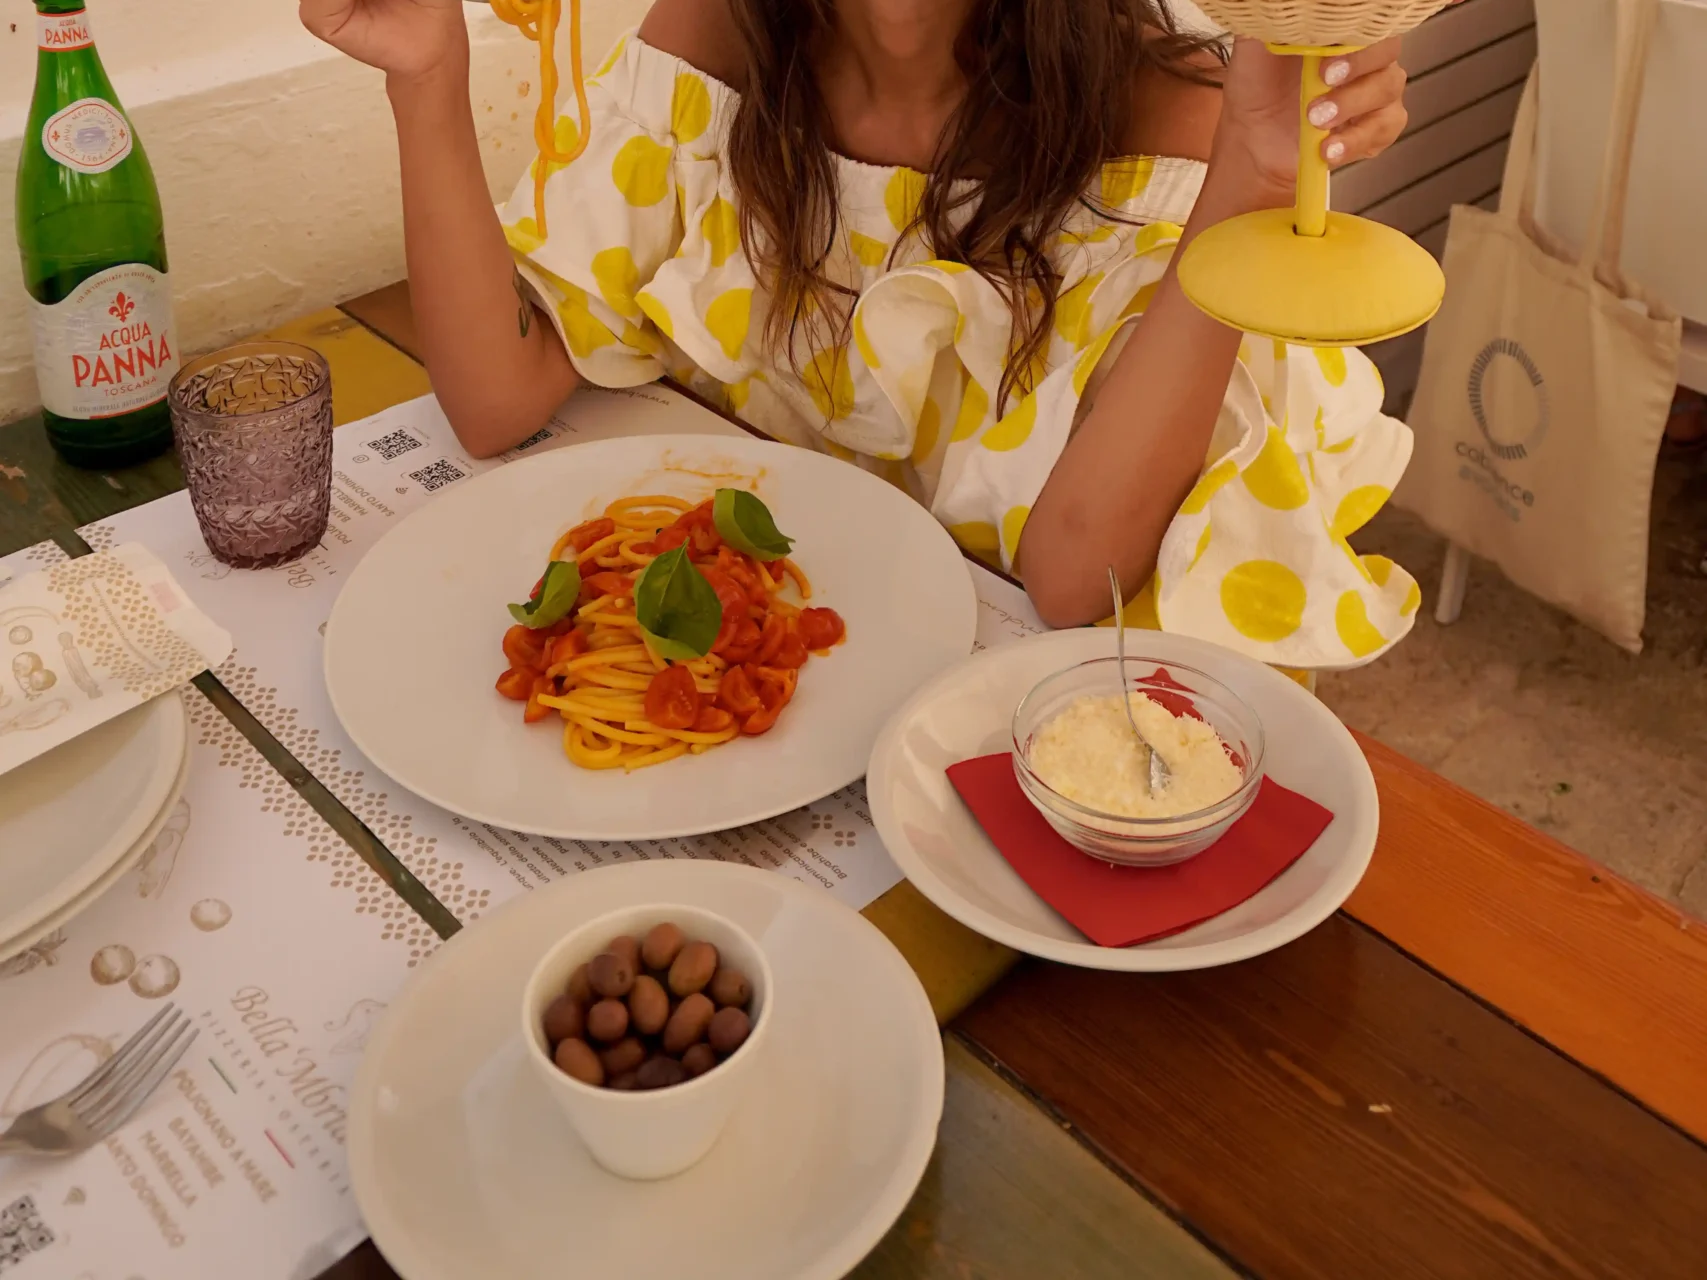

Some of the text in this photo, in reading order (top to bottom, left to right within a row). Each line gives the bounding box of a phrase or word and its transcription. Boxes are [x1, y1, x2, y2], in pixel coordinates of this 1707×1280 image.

[45, 27, 89, 44] PANNA
[99, 321, 151, 350] ACQUA
[72, 335, 171, 387] PANNA
[104, 376, 157, 397] TOSCANA
[333, 470, 395, 518] SANTO DOMINGO
[451, 817, 462, 826] la
[467, 831, 508, 866] L'equilibrio
[532, 845, 567, 876] selezione
[611, 850, 622, 859] la
[758, 849, 782, 868] nella
[804, 848, 847, 879] Bayahibe
[782, 847, 834, 889] Dominicana
[231, 984, 298, 1058] Bella
[242, 1159, 278, 1204] MARE
